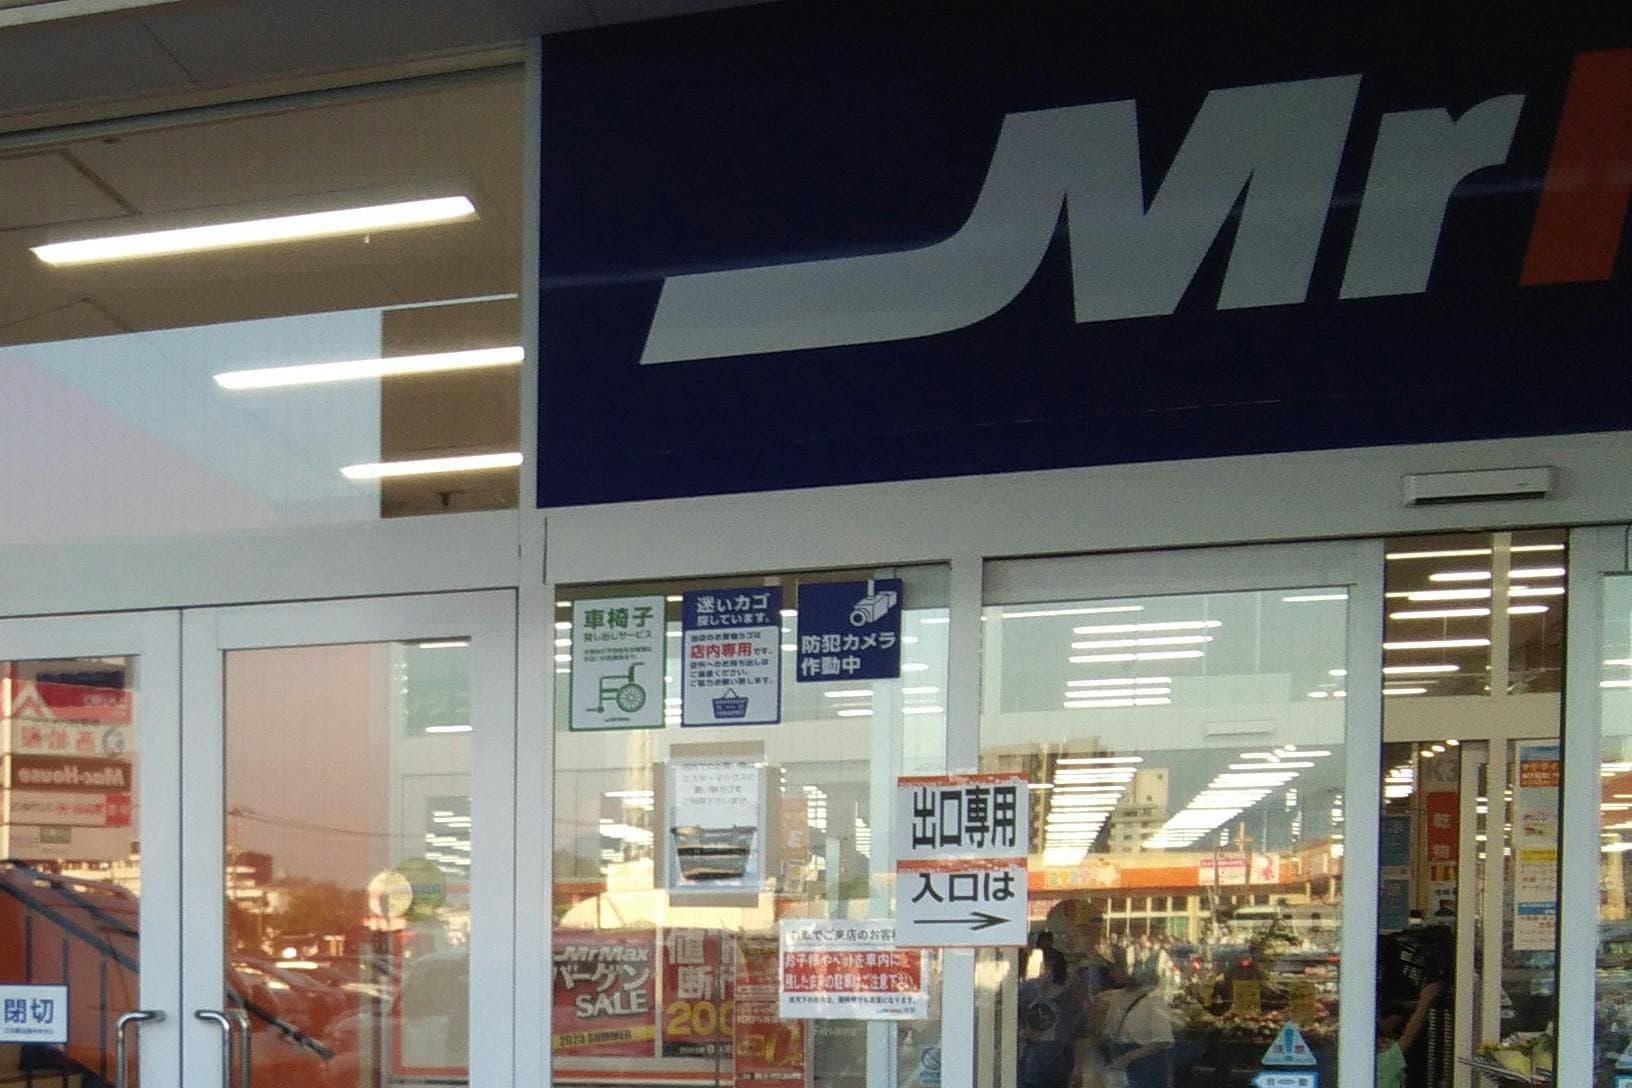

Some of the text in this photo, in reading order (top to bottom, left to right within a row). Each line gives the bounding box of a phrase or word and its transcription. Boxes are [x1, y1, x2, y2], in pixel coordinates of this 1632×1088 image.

[696, 593, 770, 614] 迷いカゴ
[584, 606, 654, 630] 車椅子
[697, 613, 770, 627] 探しています。
[584, 631, 653, 643] 貸し出しサービス
[801, 631, 897, 655] 防犯カメラ
[801, 656, 861, 677] 作動中
[912, 785, 1017, 850] 出口専用
[911, 871, 1015, 904] 入口は
[553, 962, 650, 992] バーゲン
[4, 998, 54, 1025] 閉切
[575, 988, 649, 1019] SALE
